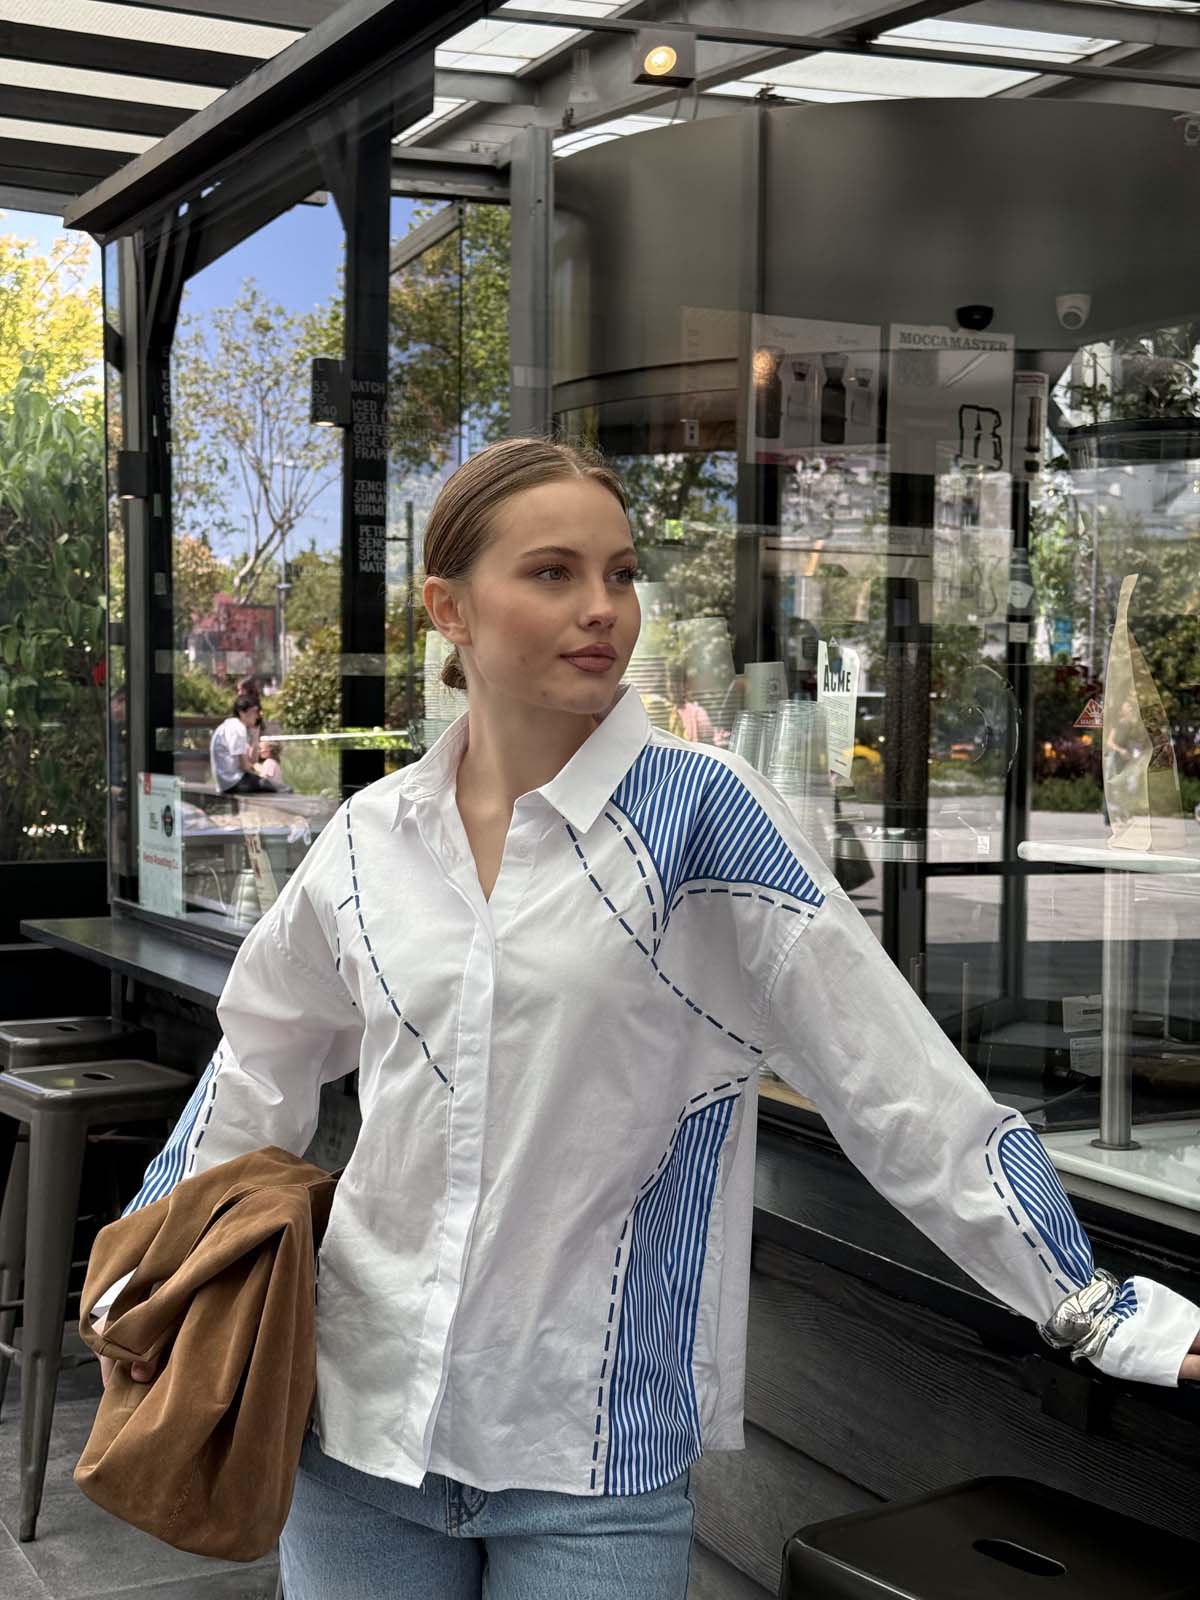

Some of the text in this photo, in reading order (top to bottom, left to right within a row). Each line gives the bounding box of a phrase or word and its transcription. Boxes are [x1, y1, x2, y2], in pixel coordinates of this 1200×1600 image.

[899, 332, 1008, 352] MOCCAMASTER
[351, 380, 386, 394] BATCH
[352, 399, 377, 412] ICED
[353, 411, 378, 424] ICED
[823, 664, 851, 692] ACME
